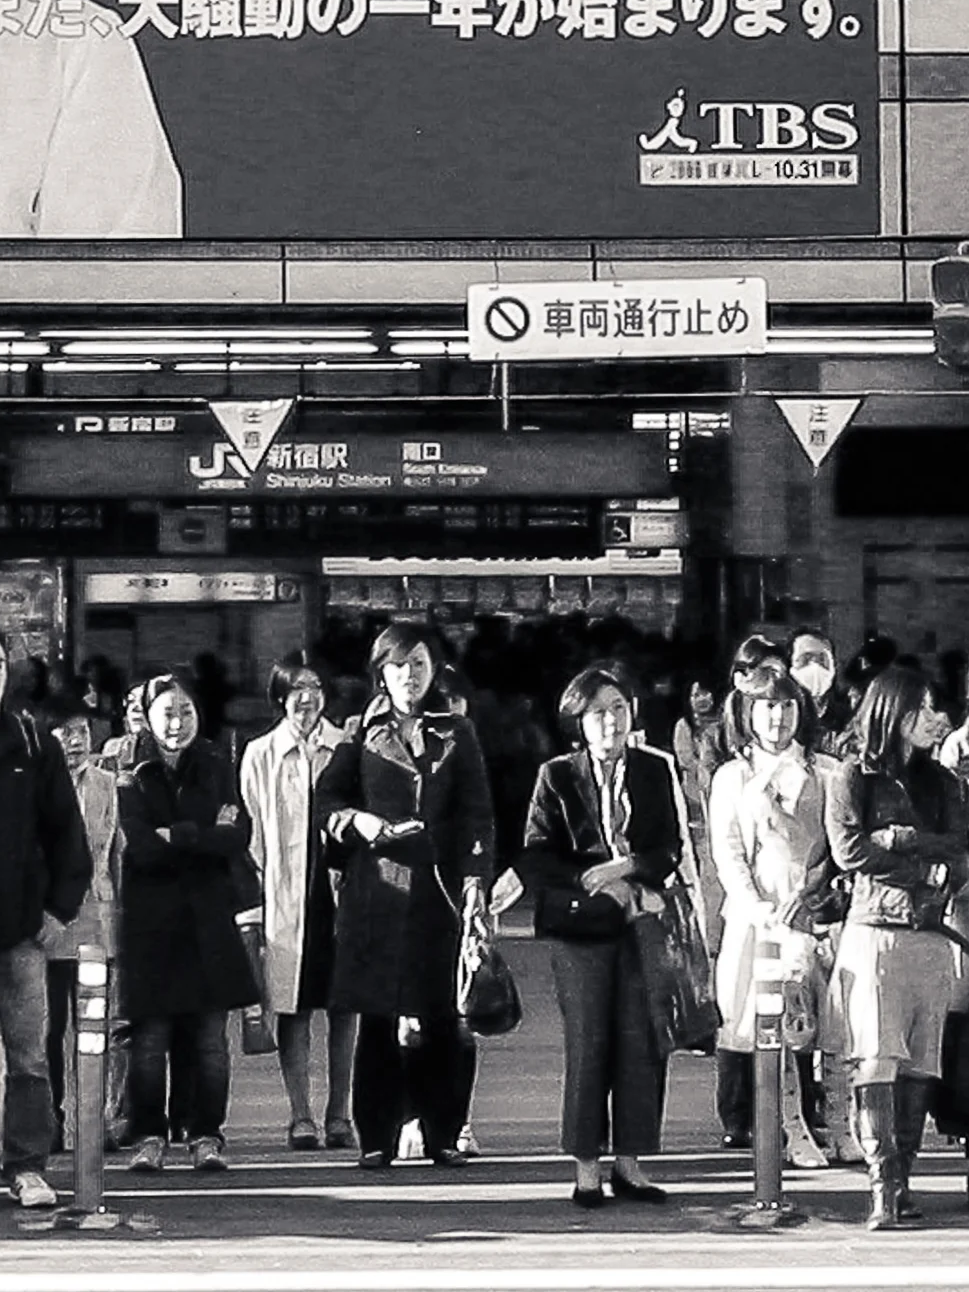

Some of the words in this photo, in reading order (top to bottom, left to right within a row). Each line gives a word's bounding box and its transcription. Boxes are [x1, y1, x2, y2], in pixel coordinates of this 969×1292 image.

[699, 103, 859, 151] TBS
[543, 298, 750, 339] 車両通行止め
[266, 443, 348, 470] 新宿駅
[266, 472, 333, 490] Shinjuku
[338, 472, 392, 488] Station
